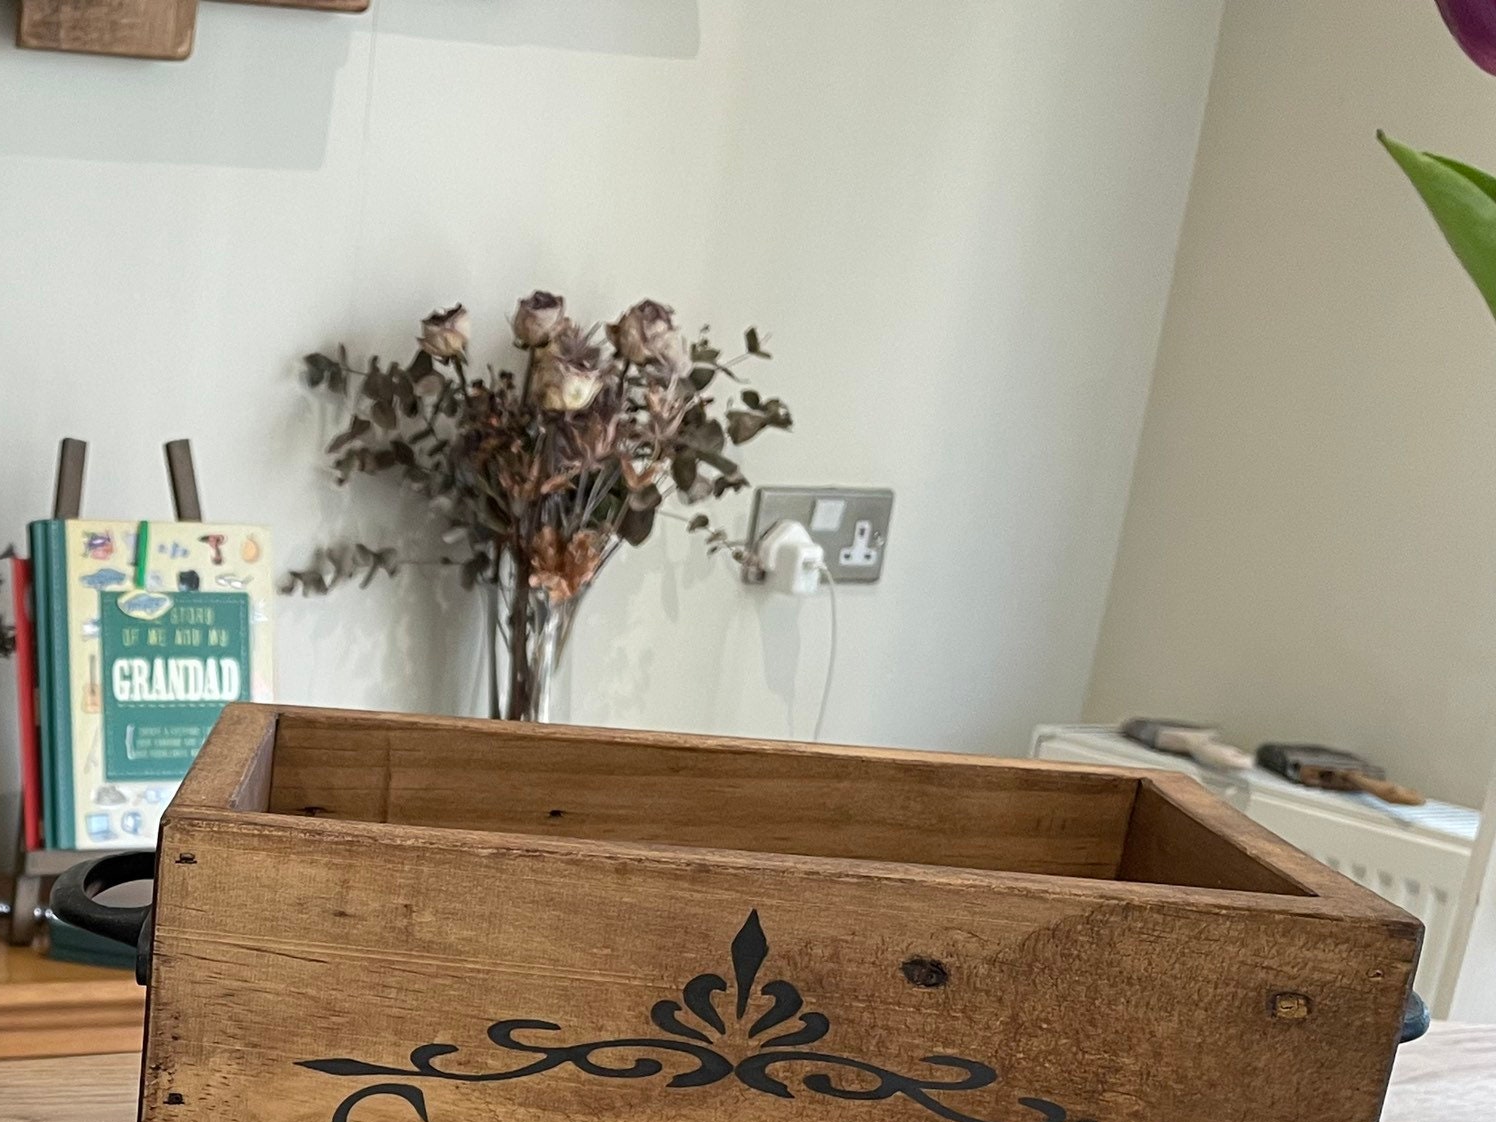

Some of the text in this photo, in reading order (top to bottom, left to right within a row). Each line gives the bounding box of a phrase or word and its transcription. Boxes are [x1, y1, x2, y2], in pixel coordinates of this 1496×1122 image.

[122, 627, 140, 646] OF
[174, 627, 201, 646] AND
[112, 656, 241, 702] GRANDAD
